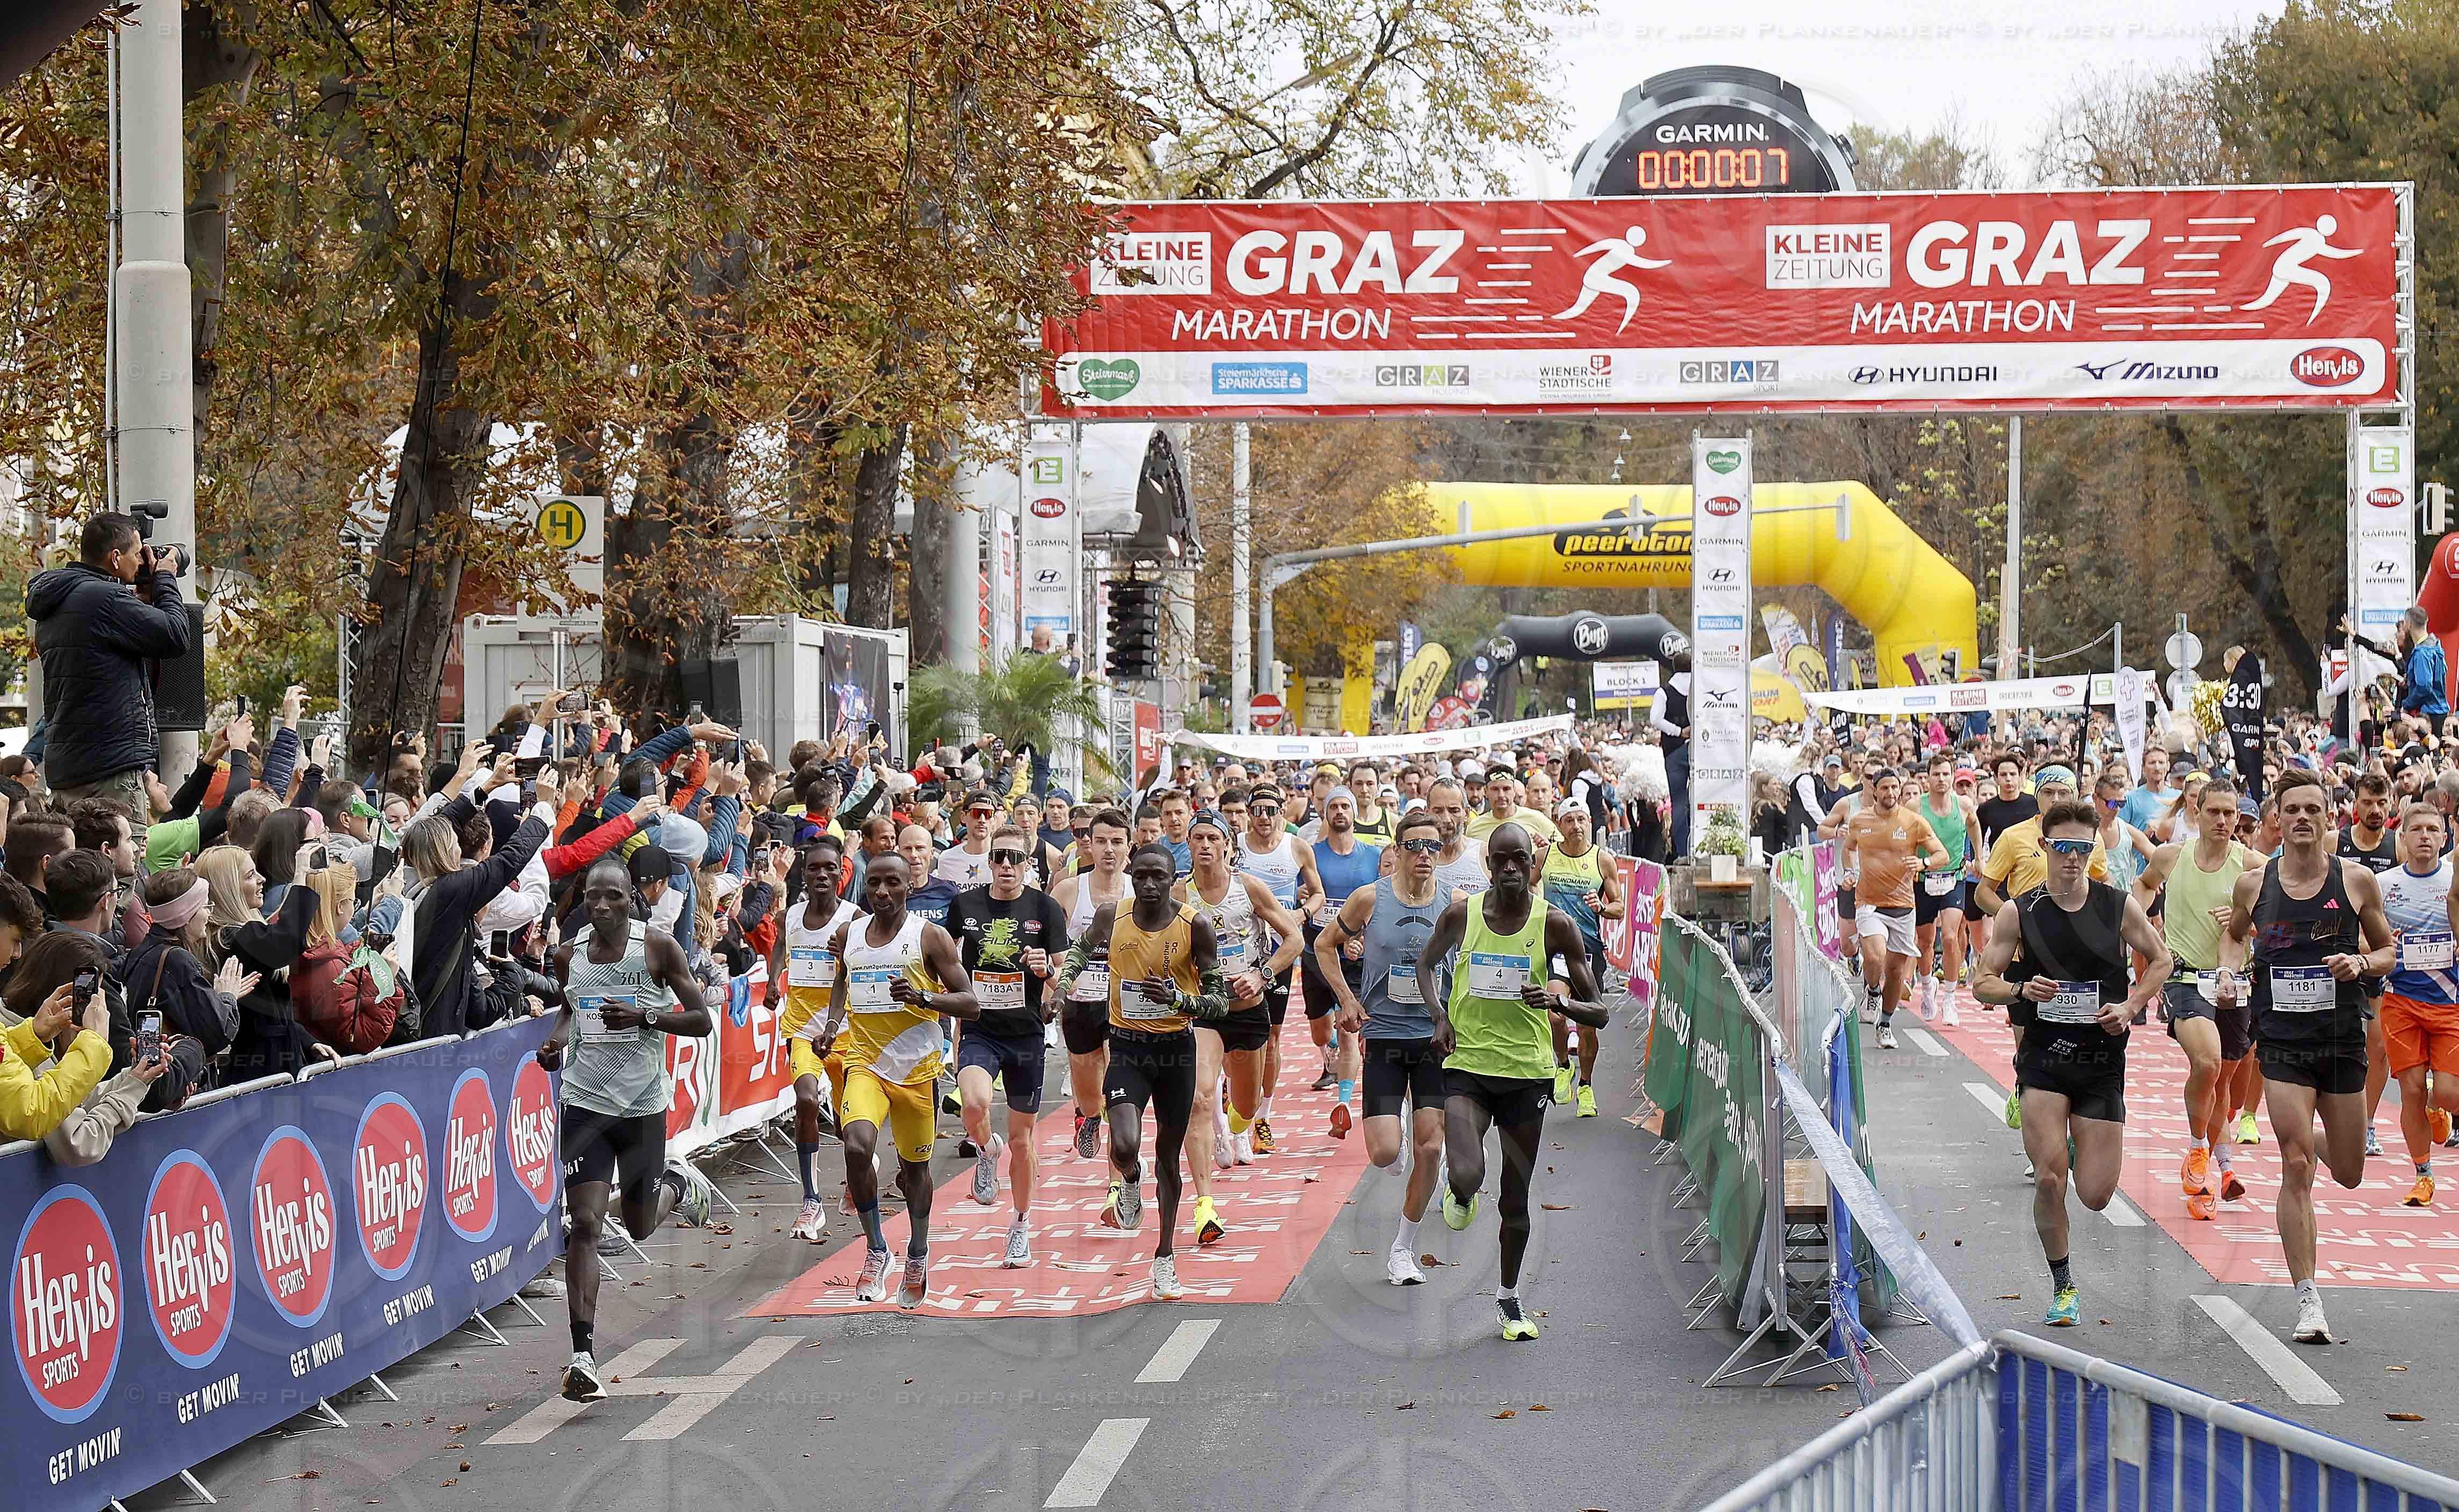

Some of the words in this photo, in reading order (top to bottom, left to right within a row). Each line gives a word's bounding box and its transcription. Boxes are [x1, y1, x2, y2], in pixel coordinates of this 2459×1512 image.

[1656, 123, 1769, 143] GARMIN
[1773, 232, 1883, 255] KLEINE
[1906, 219, 2152, 288] GRAZ
[1226, 229, 1465, 296] GRAZ
[1773, 257, 1883, 280] ZEITUNG
[1098, 265, 1203, 286] ZUNG
[1172, 308, 1392, 341] MARATHON
[1850, 299, 2076, 334] MARATHON
[1377, 365, 1469, 387] GRAZ
[1539, 366, 1588, 377] WIENER
[1680, 361, 1779, 383] GRAZ
[1889, 367, 1998, 382] HYUNDAI
[2297, 355, 2359, 380] Hervis
[1218, 377, 1288, 390] SPARKASSE
[549, 510, 573, 540] H
[2362, 529, 2408, 537] GARMIN
[1579, 623, 1608, 648] Buff
[1548, 876, 1591, 886] GRUNDMANN
[2417, 944, 2440, 954] 1177
[807, 962, 813, 970] 3
[1495, 969, 1503, 979] 4
[983, 983, 1014, 993] 7183A
[2288, 980, 2316, 992] 1181
[2056, 994, 2078, 1005] 930
[511, 1093, 555, 1175] Hervis
[447, 1113, 493, 1195] Hervis
[358, 1139, 423, 1233] Hervis
[452, 1194, 475, 1219] SPORTS
[256, 1176, 330, 1276] Hervis
[372, 1224, 396, 1253] SPORTS
[149, 1205, 230, 1315] Hervis
[470, 1258, 488, 1284] GET
[278, 1267, 306, 1298] SPORTS
[20, 1244, 116, 1361] Hervis
[383, 1302, 401, 1326] GET
[170, 1303, 201, 1338] SPORTS
[42, 1352, 79, 1391] SPORTS
[289, 1351, 310, 1379] GET
[177, 1389, 200, 1425] GET
[48, 1447, 74, 1486] GET
